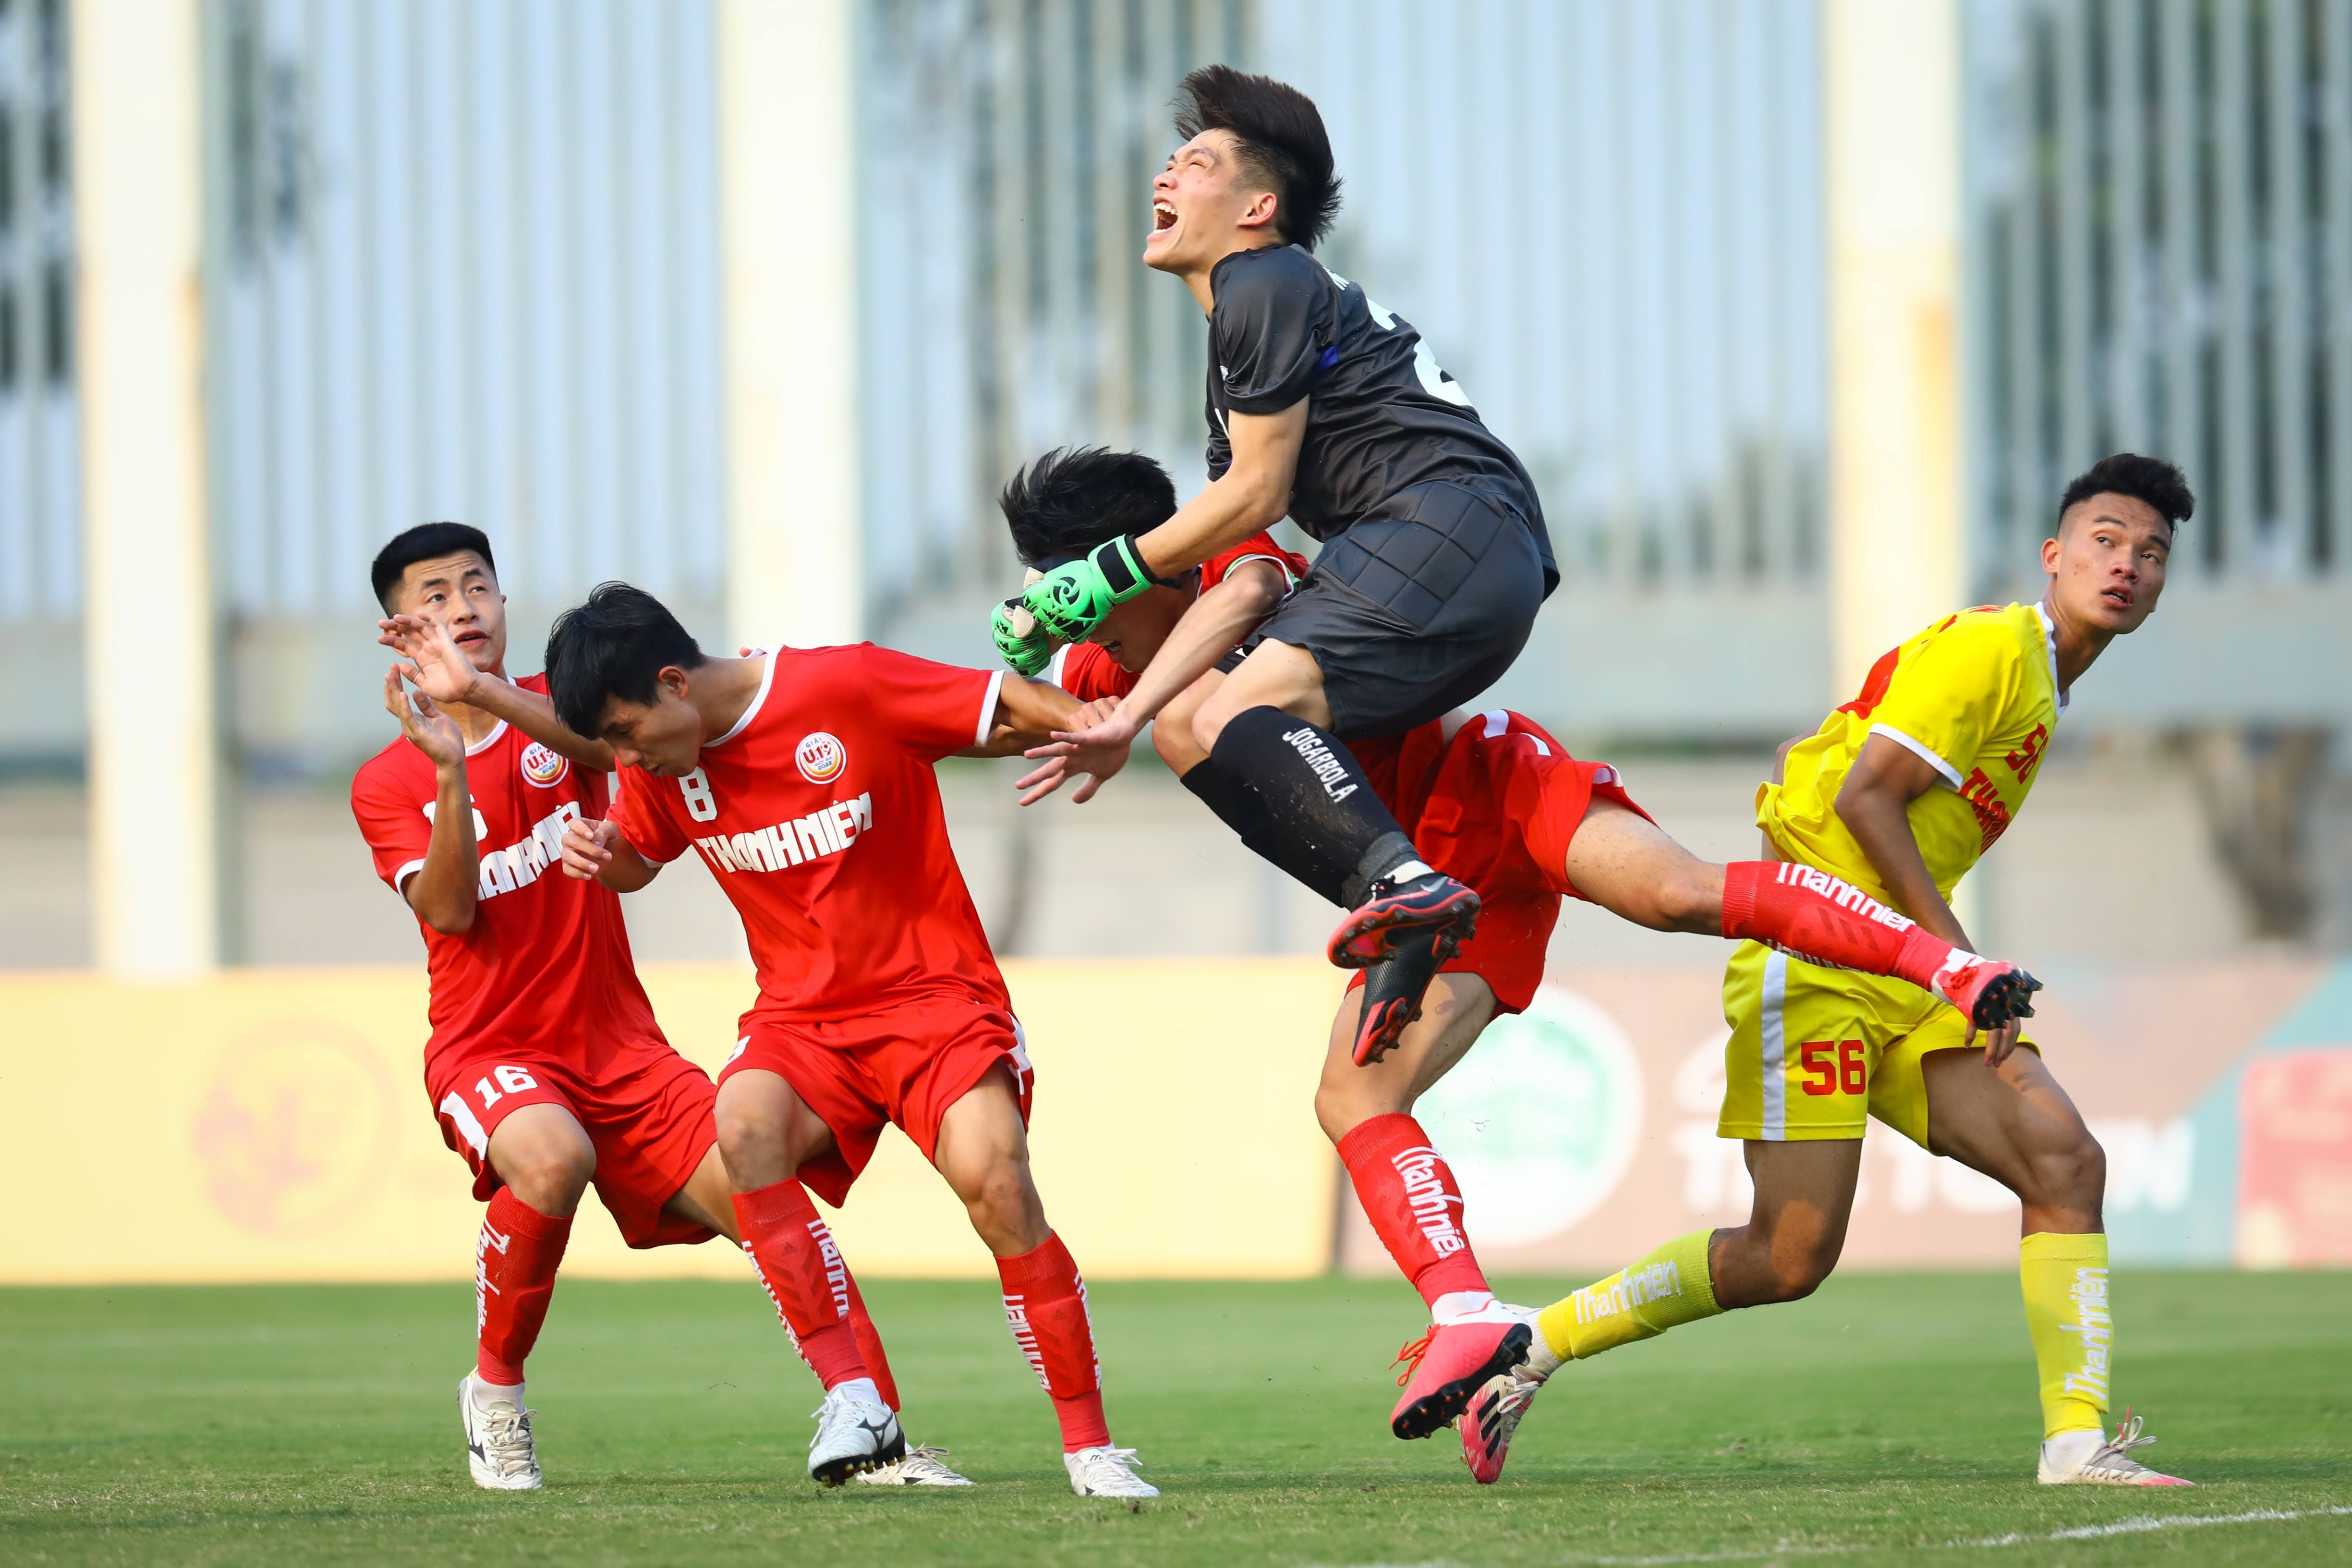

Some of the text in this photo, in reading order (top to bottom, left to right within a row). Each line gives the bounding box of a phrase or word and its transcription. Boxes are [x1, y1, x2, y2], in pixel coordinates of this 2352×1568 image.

[817, 760, 833, 771] 2022
[1282, 727, 1358, 803] JOGARBOLA
[678, 766, 718, 822] 8
[694, 791, 873, 874] THANHNIÊN
[474, 1065, 538, 1111] 16
[1801, 1040, 1866, 1096] 56
